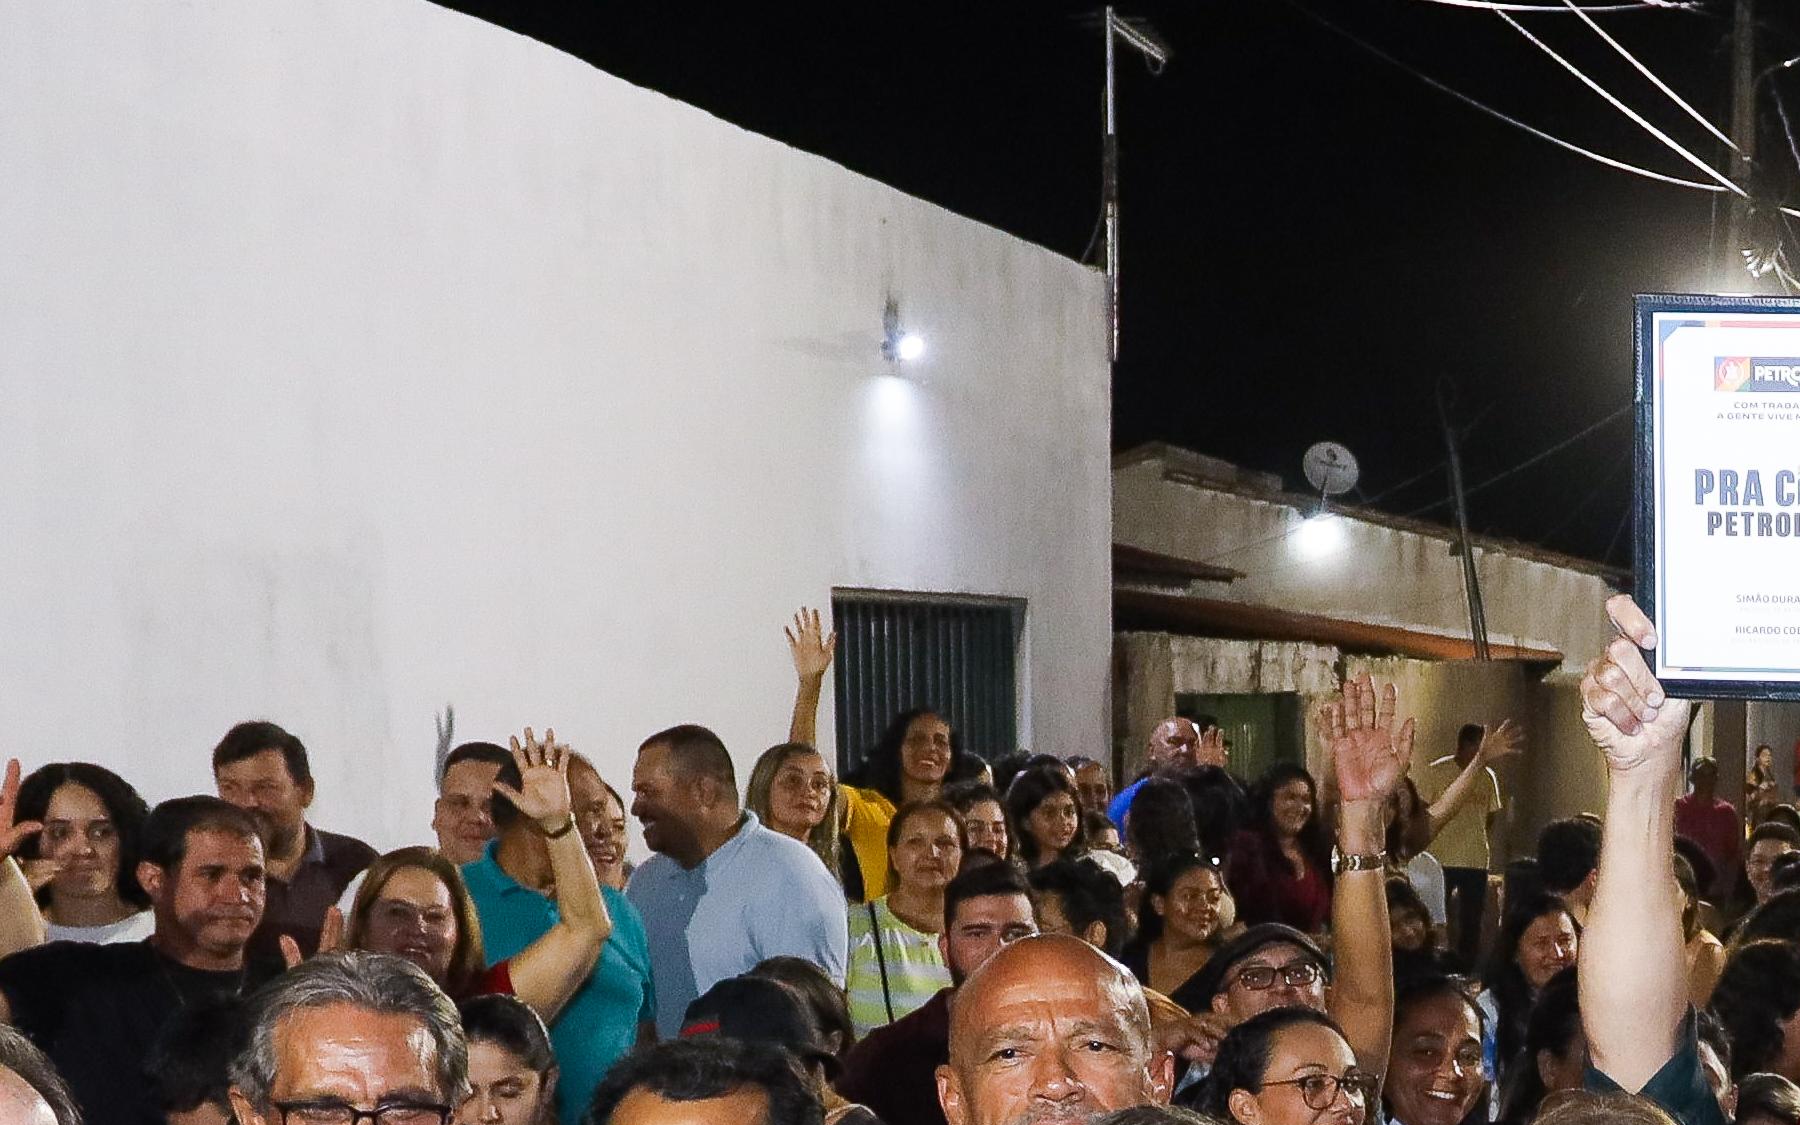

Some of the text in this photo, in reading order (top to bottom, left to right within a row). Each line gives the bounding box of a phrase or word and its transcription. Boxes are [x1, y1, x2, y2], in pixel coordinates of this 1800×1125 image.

[1695, 468, 1764, 506] PRA
[1736, 593, 1769, 603] SIMÃO
[1735, 626, 1781, 635] RICARDO
